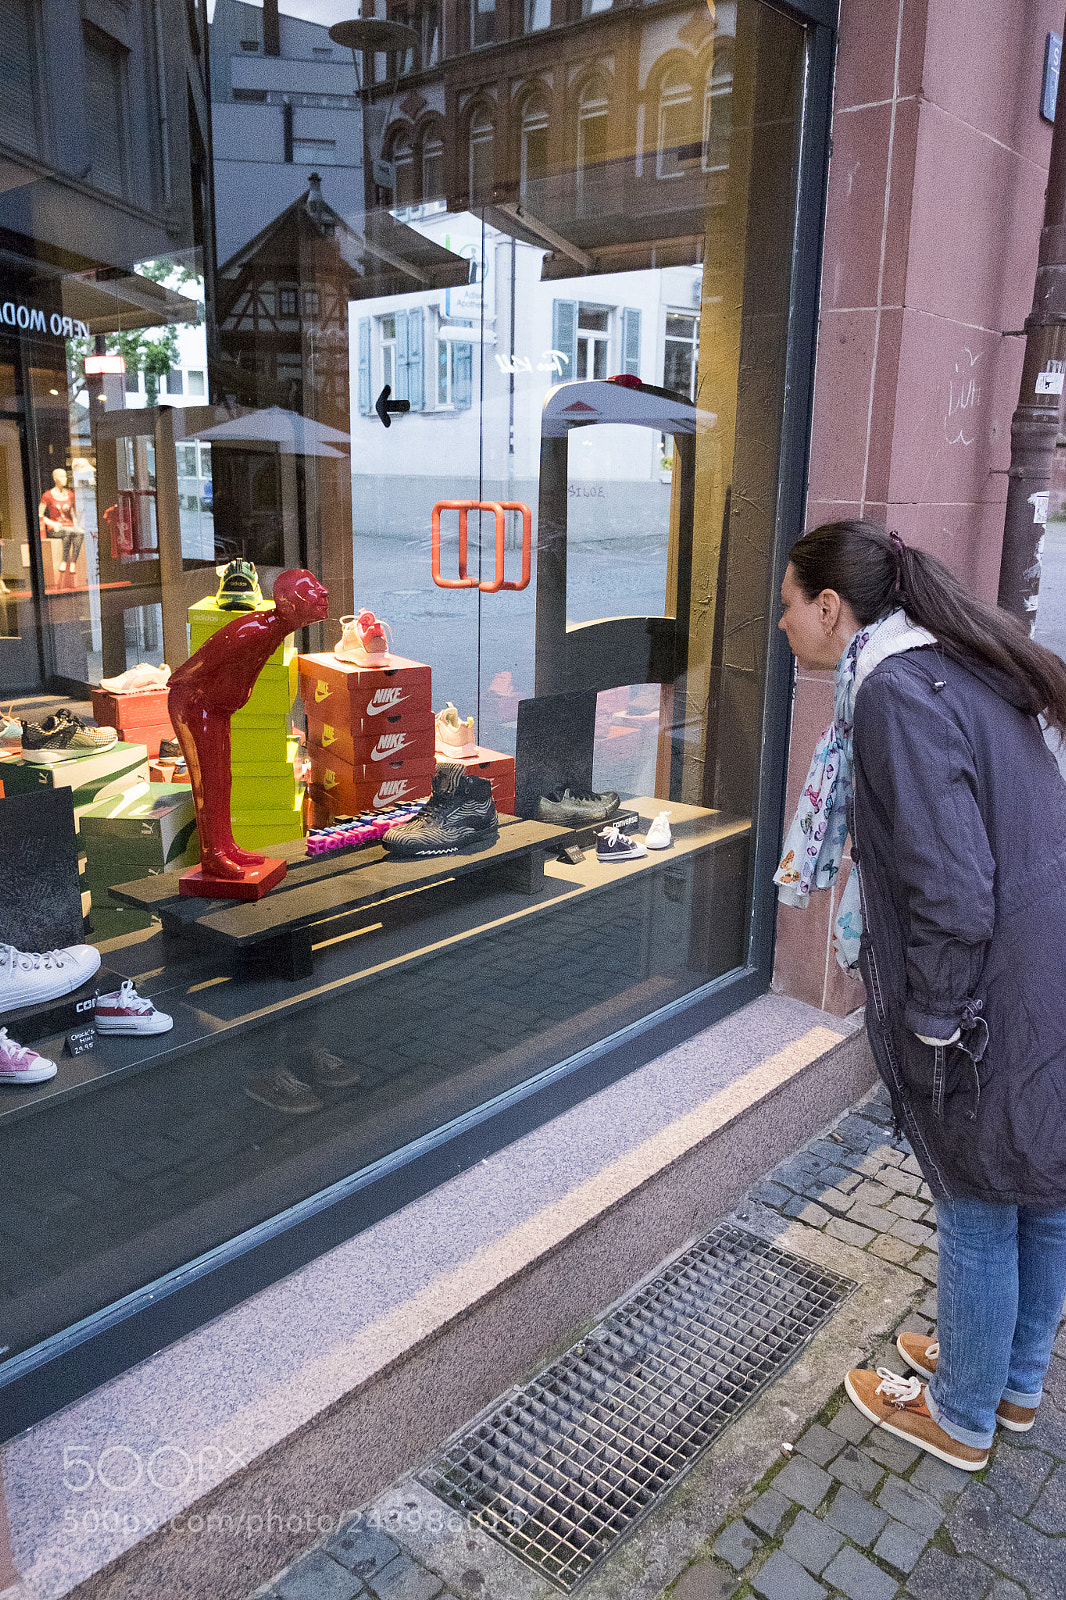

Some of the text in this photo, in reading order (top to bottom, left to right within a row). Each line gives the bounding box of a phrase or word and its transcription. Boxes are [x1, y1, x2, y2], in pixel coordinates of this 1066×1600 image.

[373, 687, 402, 704] NIKE
[377, 733, 407, 750] NIKE
[379, 779, 409, 796] NIKE
